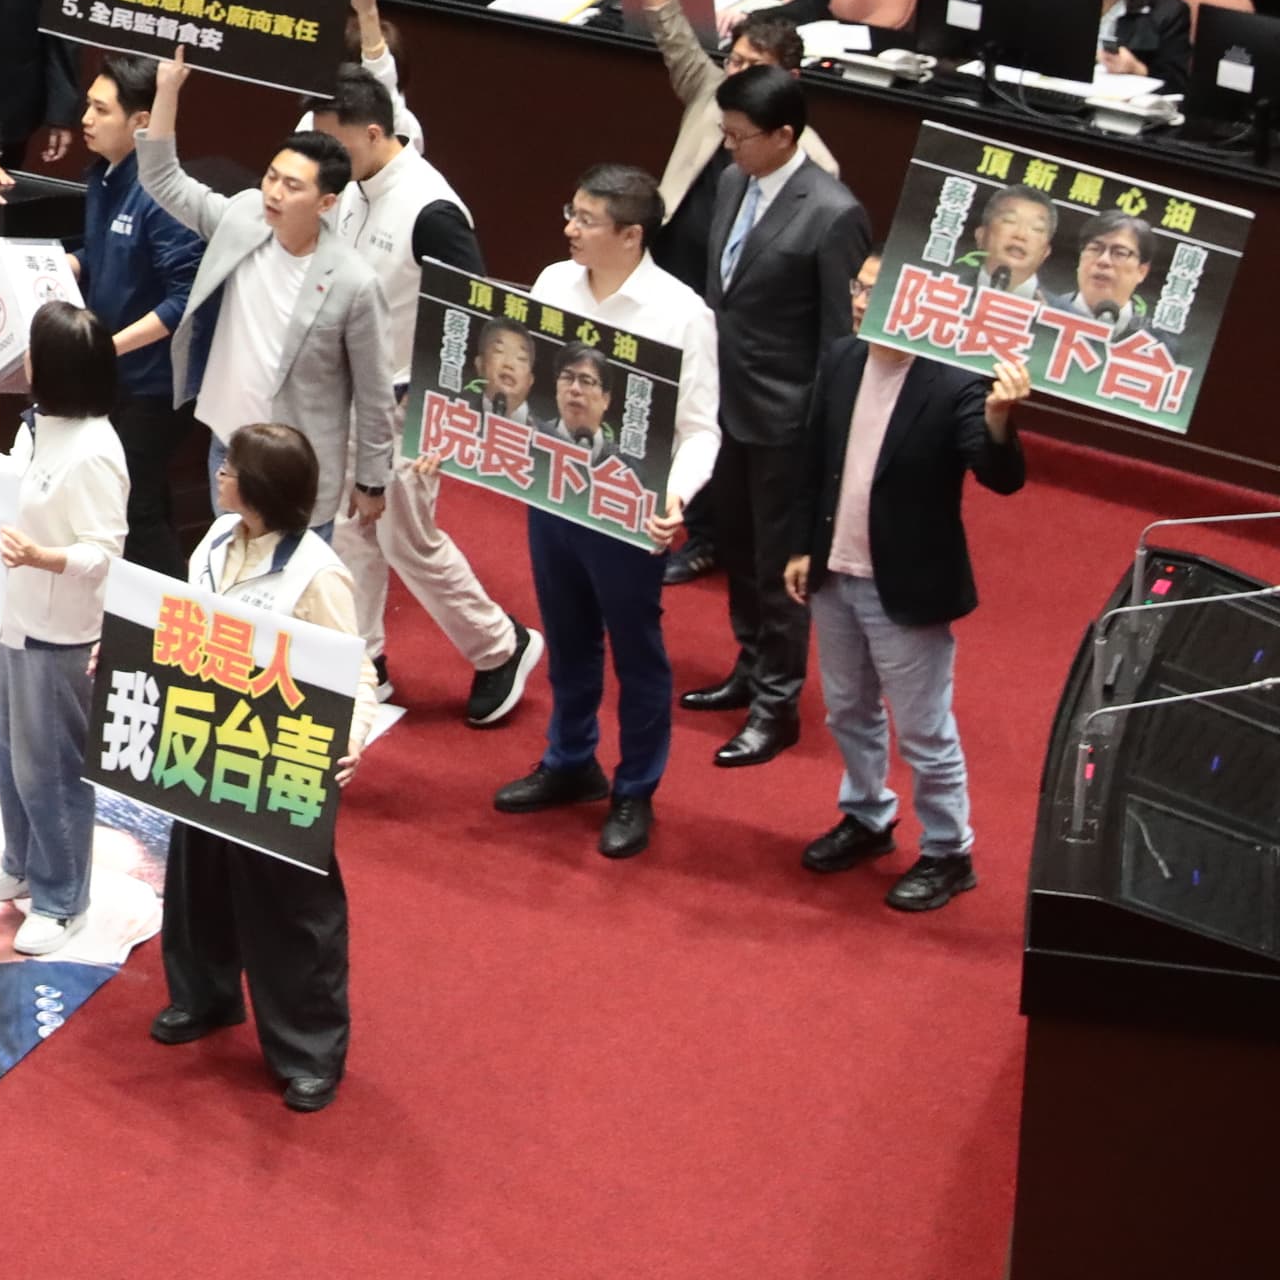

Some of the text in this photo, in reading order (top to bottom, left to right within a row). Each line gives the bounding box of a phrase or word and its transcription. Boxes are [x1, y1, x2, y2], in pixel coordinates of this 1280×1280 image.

[89, 1, 224, 52] 全民監督食安
[976, 144, 1198, 234] 頂新黑心油
[468, 279, 639, 363] 頂新黑心油
[884, 263, 1194, 415] 院長下台!
[152, 592, 307, 711] 我是人
[100, 670, 336, 829] 我反台毒
